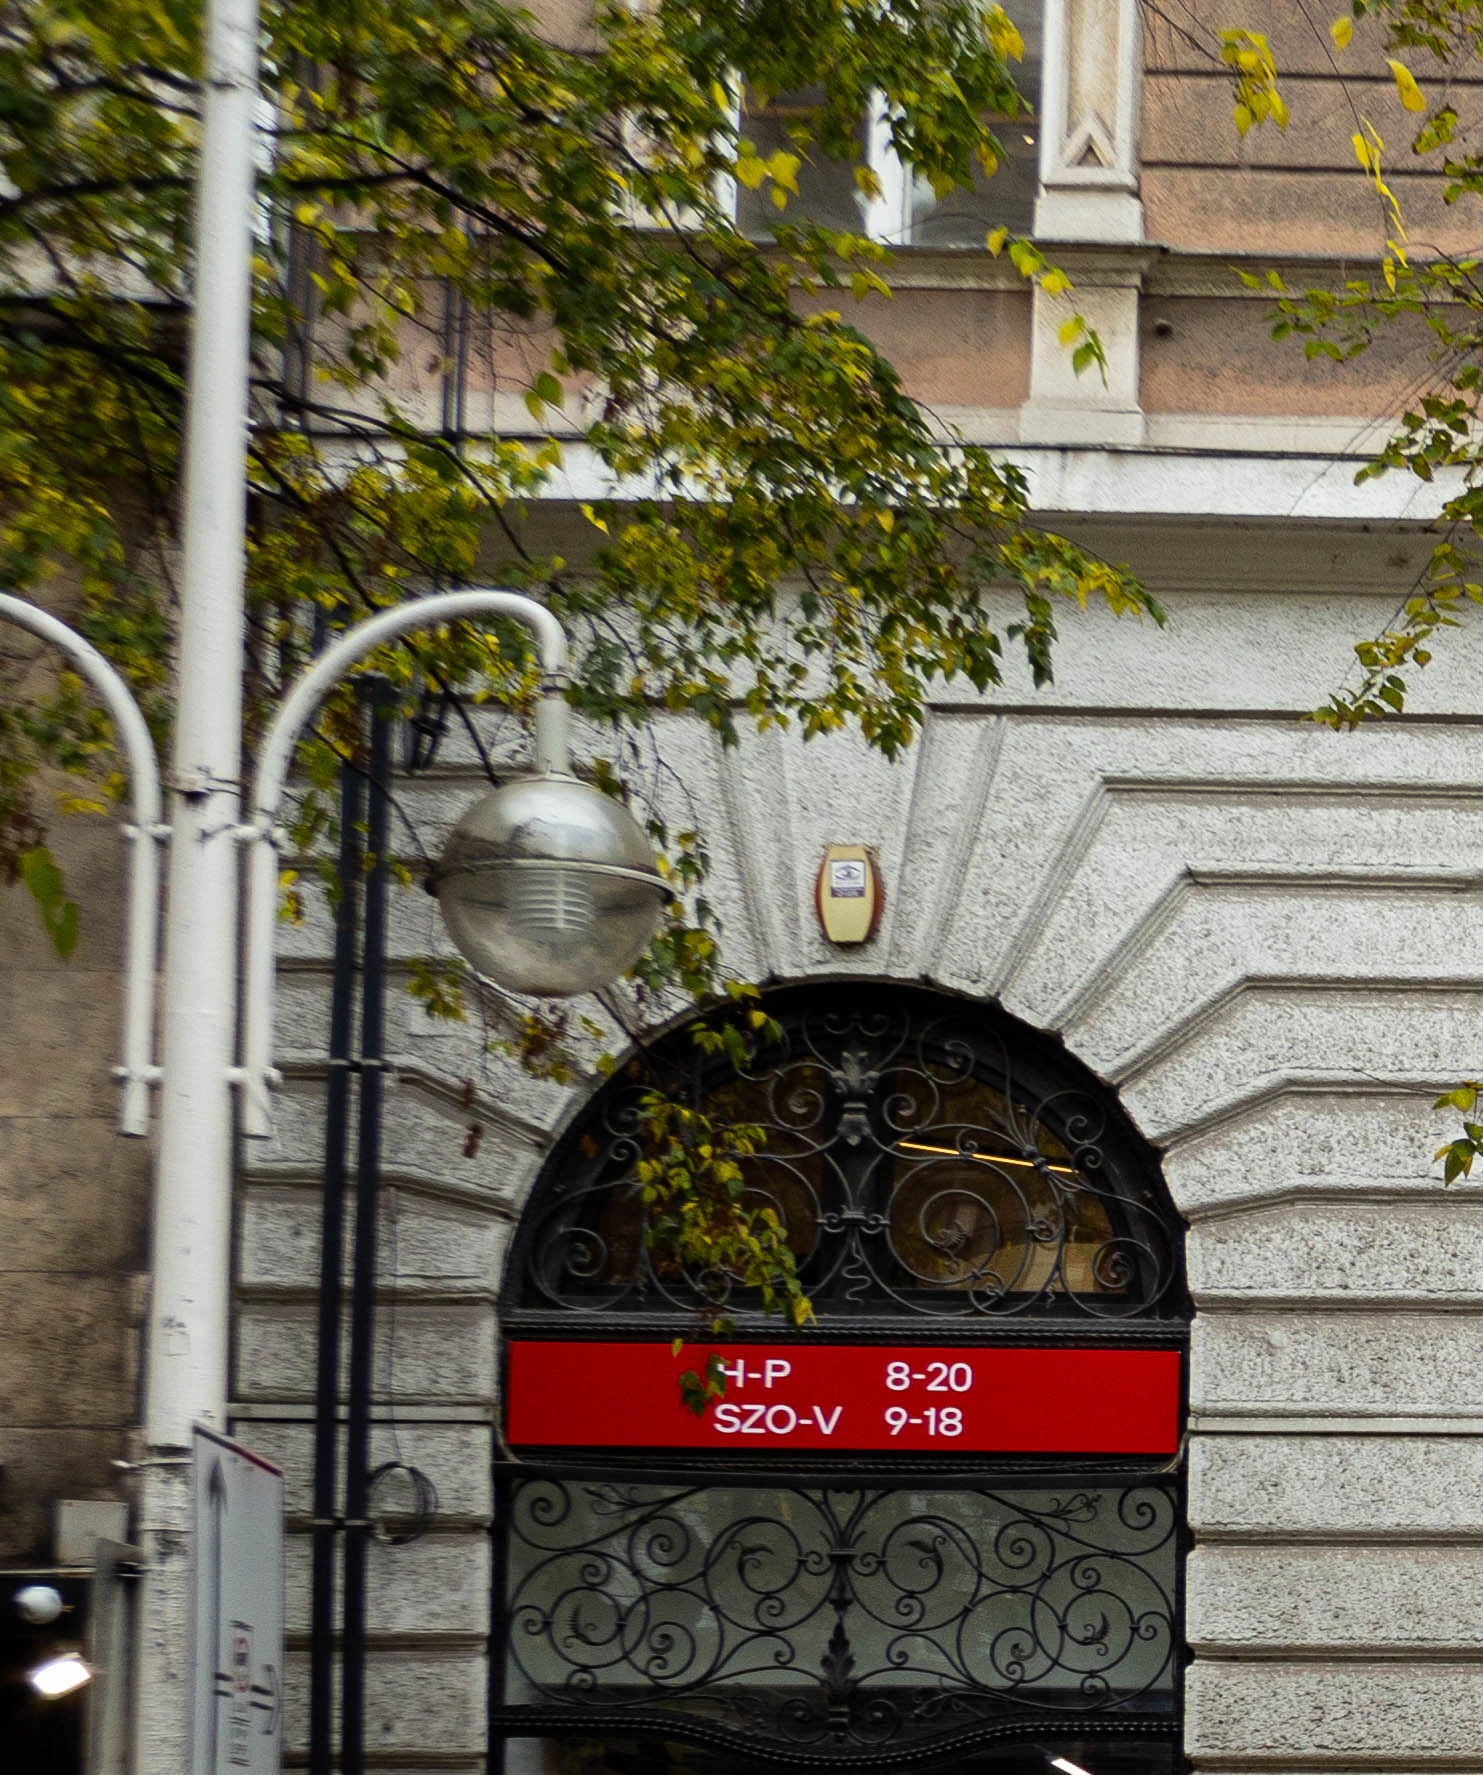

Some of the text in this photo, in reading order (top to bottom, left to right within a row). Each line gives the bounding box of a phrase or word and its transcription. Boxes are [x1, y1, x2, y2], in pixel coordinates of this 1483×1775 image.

[885, 1361, 973, 1393] 8-20
[713, 1404, 963, 1437] SZO-V 9-18
